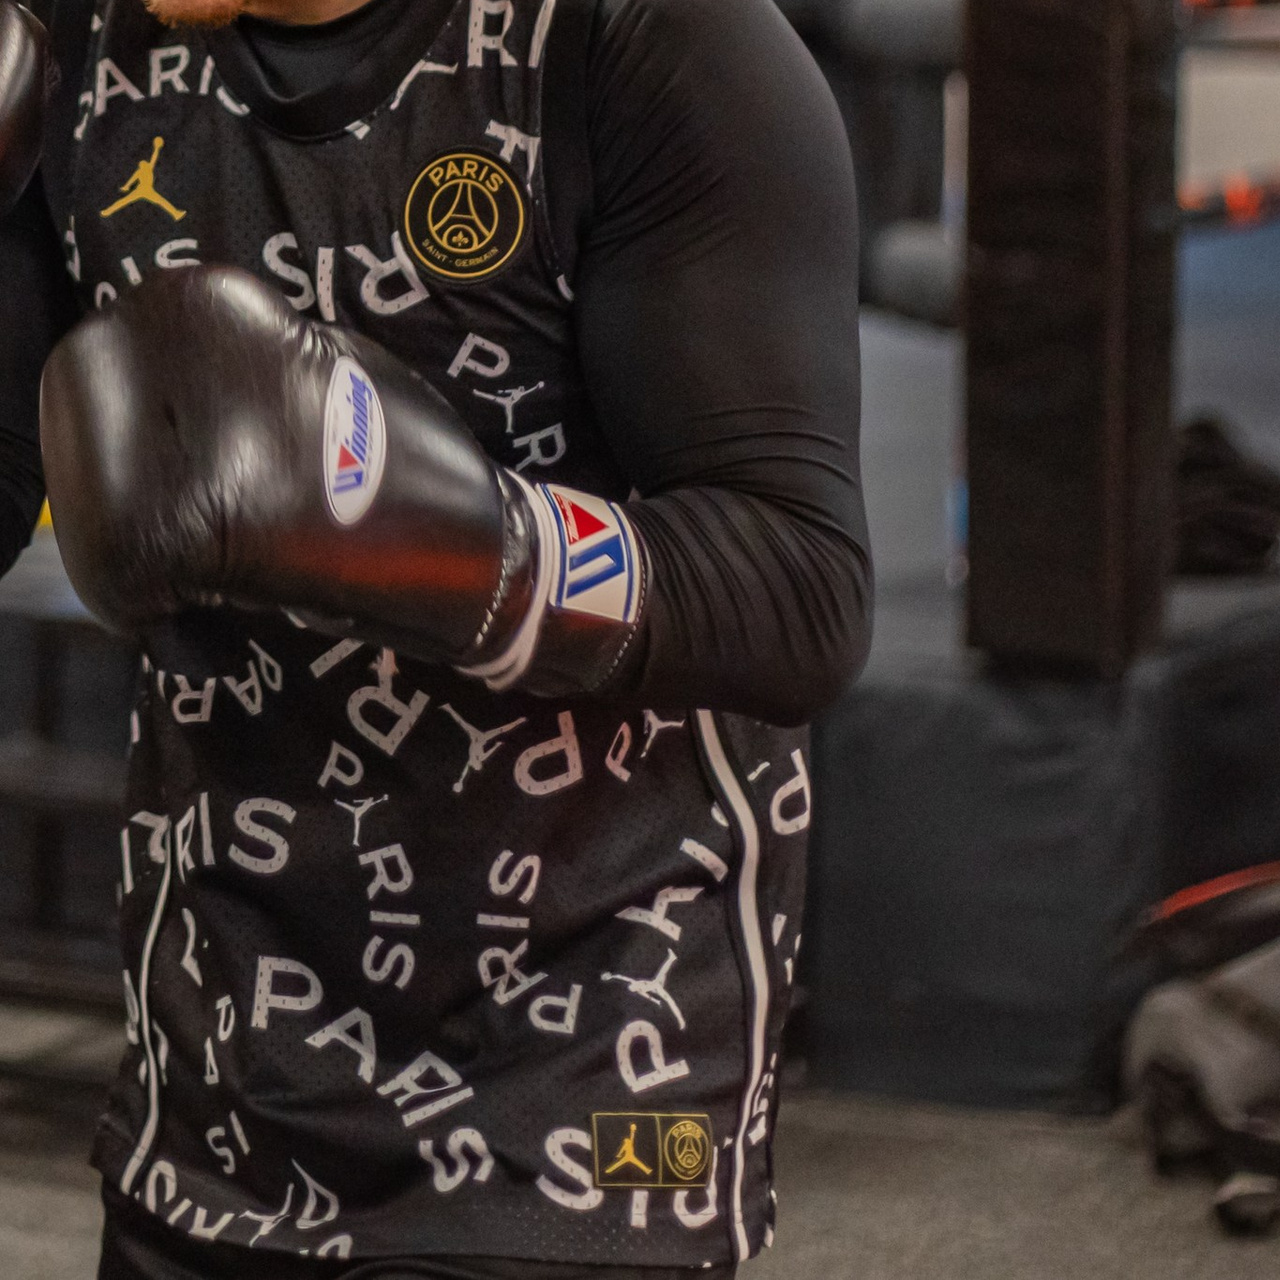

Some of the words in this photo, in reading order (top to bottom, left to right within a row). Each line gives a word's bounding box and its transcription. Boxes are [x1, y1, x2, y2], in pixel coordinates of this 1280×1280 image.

[428, 160, 504, 192] PARIS
[476, 849, 582, 1034] PARIS
[251, 954, 495, 1193] PARIS
